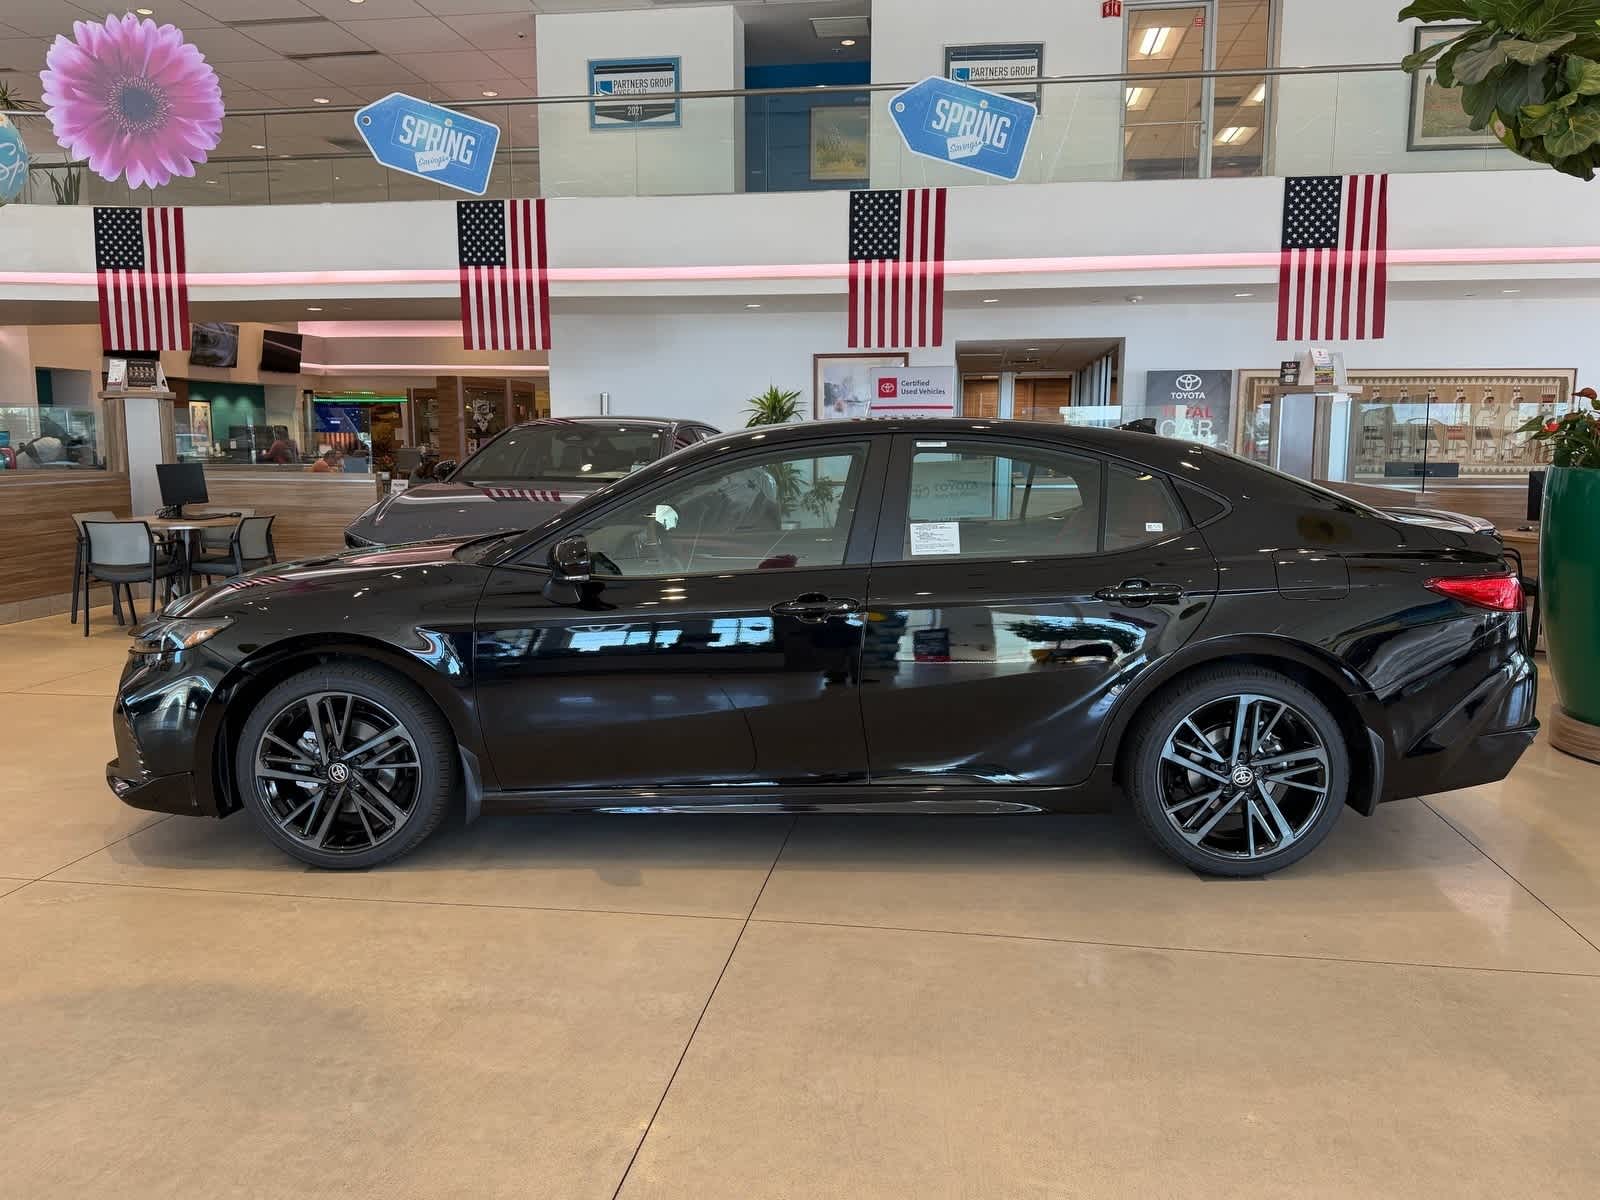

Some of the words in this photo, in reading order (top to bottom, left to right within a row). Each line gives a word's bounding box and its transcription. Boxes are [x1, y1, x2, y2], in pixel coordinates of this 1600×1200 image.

[971, 66, 1009, 77] PARTNERS
[1010, 65, 1036, 76] GROUP
[613, 79, 649, 89] PARTNERS
[650, 77, 674, 88] GROUP
[627, 106, 643, 116] 2021
[931, 99, 1012, 149] SPRING
[399, 115, 476, 165] SPRING
